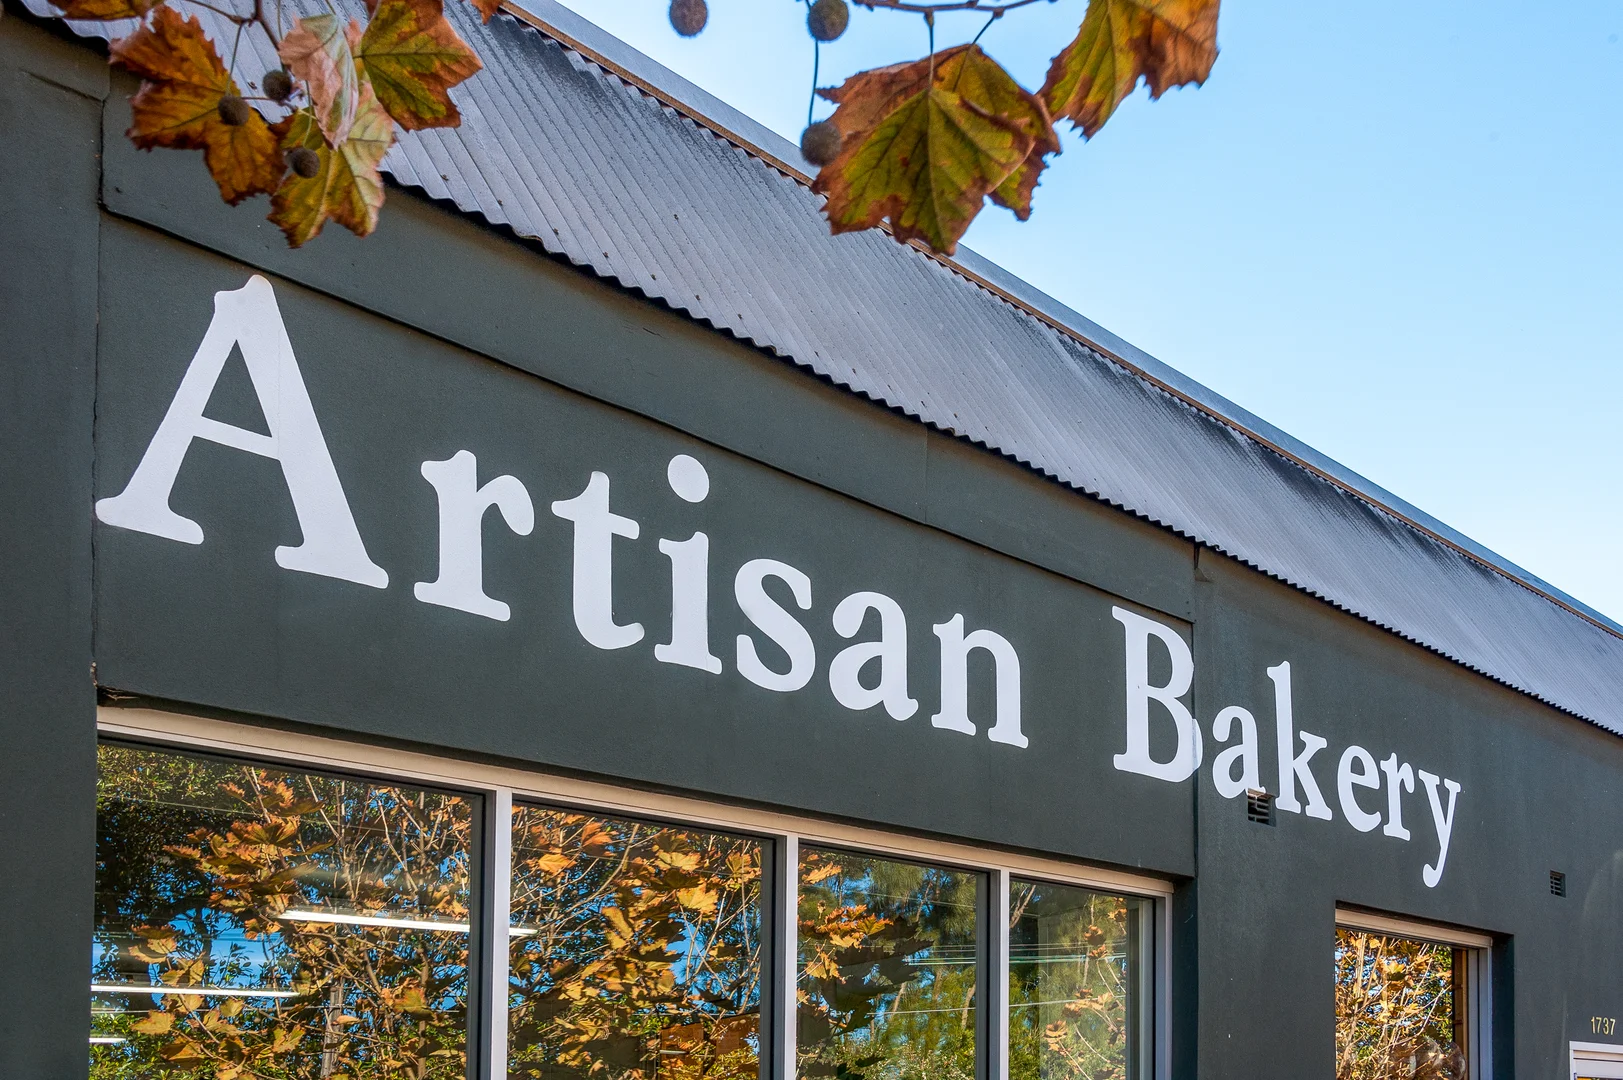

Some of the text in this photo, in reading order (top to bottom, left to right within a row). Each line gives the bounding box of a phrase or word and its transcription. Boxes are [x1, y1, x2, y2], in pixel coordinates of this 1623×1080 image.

[95, 274, 1462, 889] Artisan Bakery
[1590, 1016, 1616, 1036] 1737
